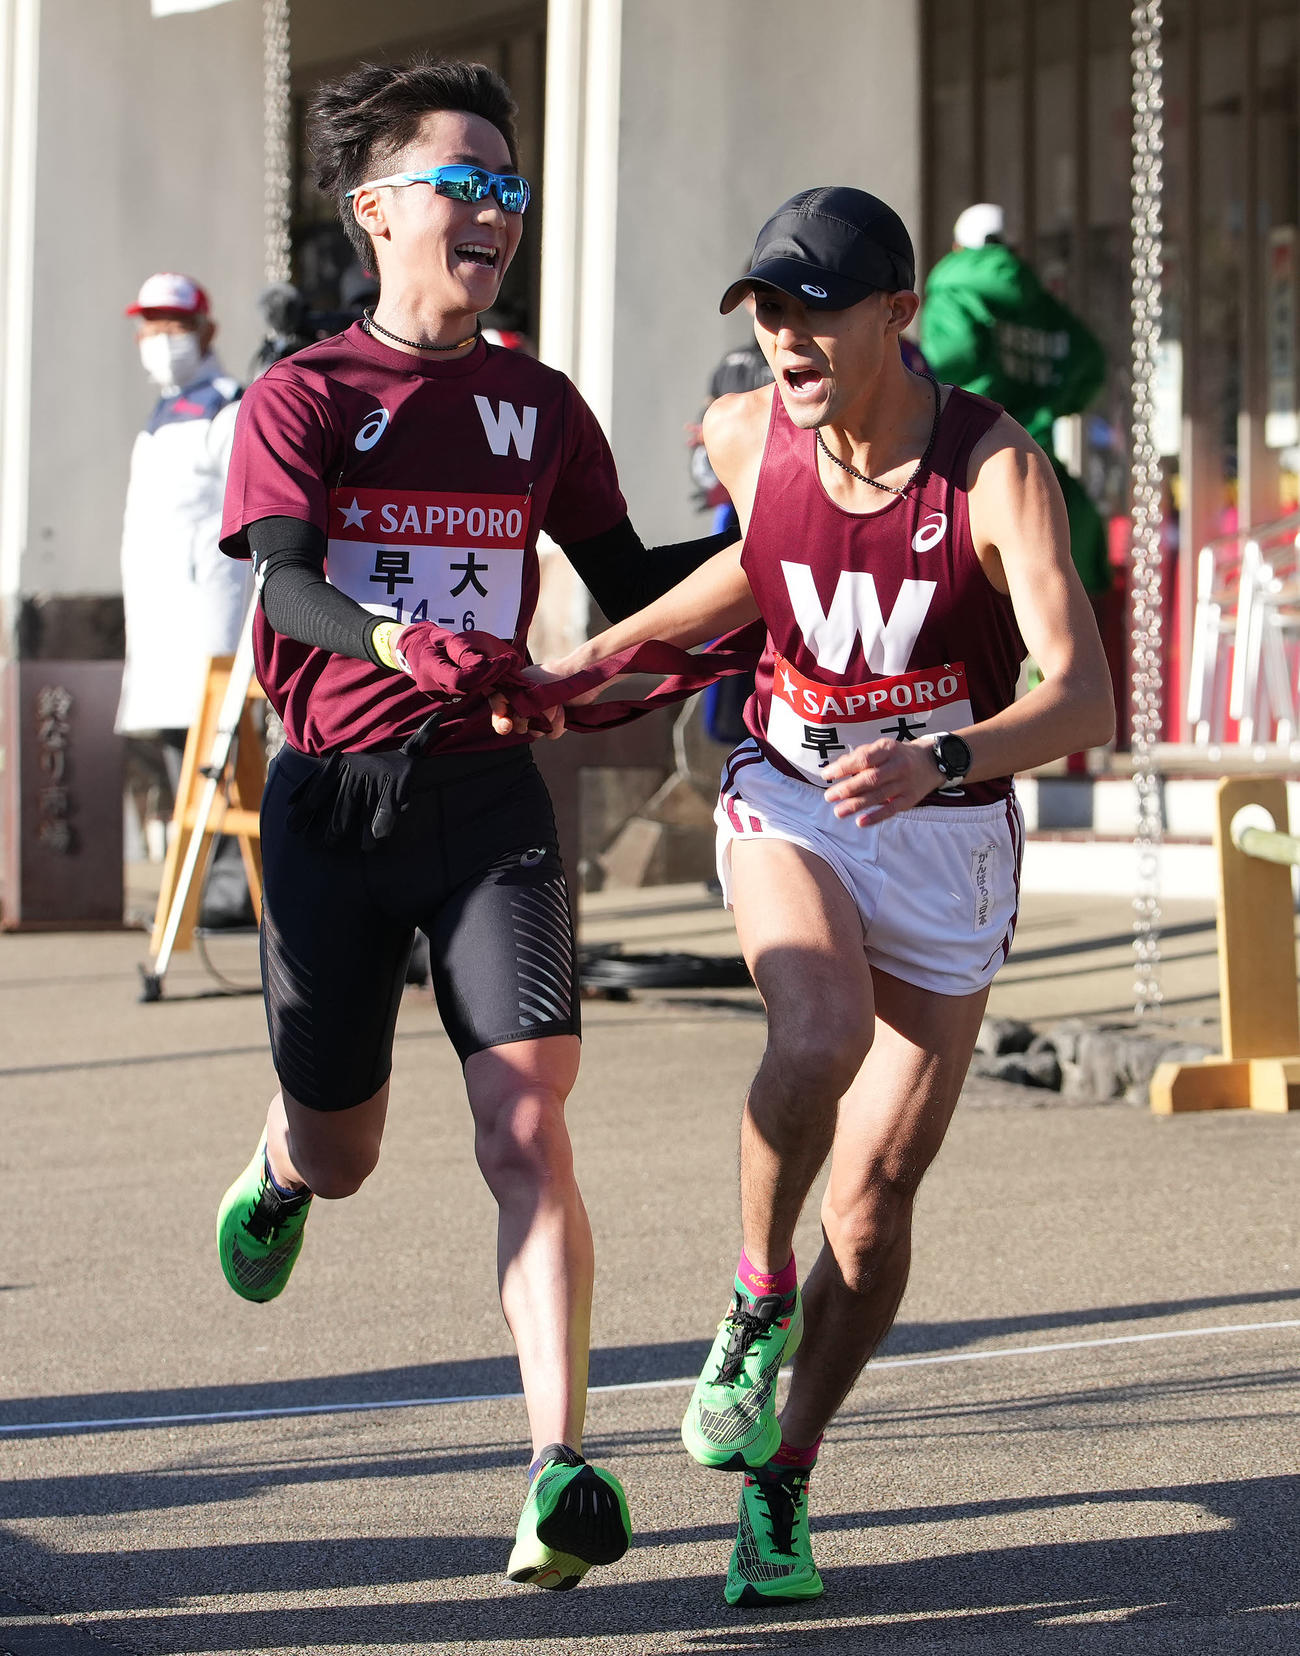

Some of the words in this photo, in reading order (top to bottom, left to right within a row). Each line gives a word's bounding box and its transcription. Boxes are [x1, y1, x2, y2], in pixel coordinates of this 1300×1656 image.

[473, 394, 538, 462] W
[379, 502, 523, 539] SAPPORO
[779, 559, 938, 677] W
[801, 675, 960, 717] SAPPORO
